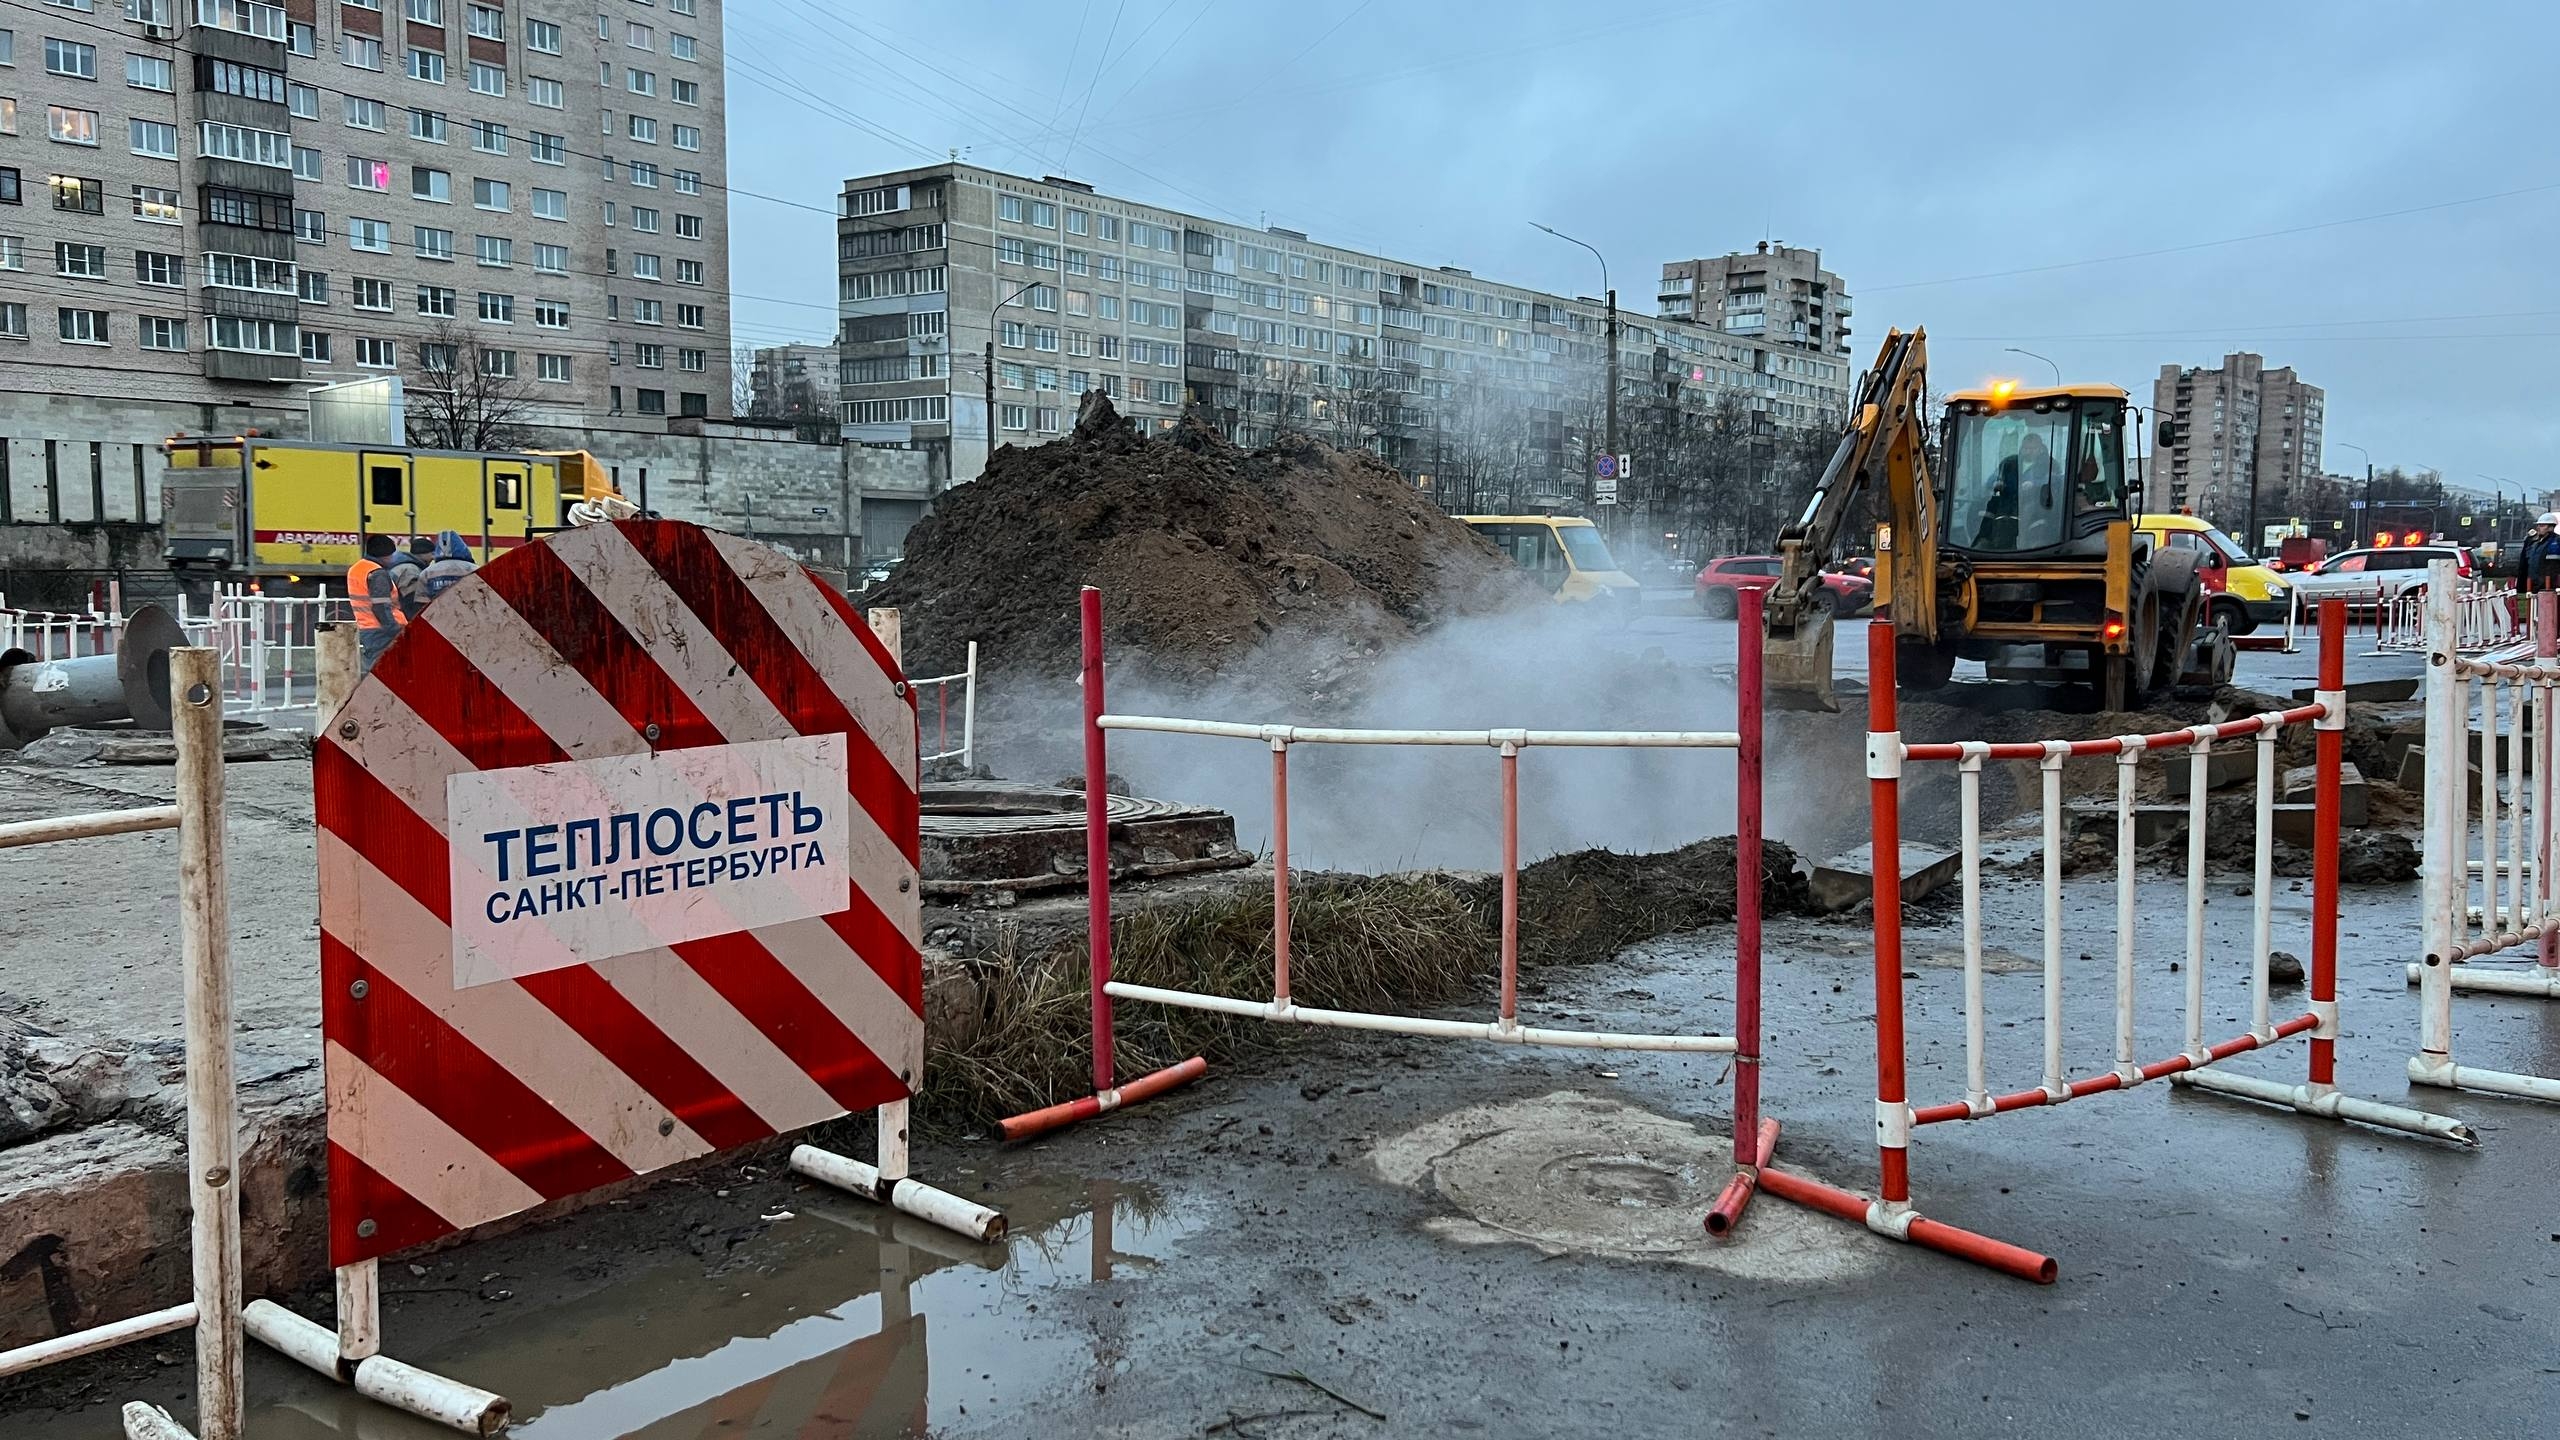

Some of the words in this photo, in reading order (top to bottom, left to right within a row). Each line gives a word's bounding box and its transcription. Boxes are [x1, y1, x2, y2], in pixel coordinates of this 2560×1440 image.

[275, 531, 359, 544] АВАРИЙНАЯ
[483, 791, 823, 882] ТЕПЛОСЕТЬ
[486, 840, 825, 924] САНКТ-ПЕТЕРБУРГА
